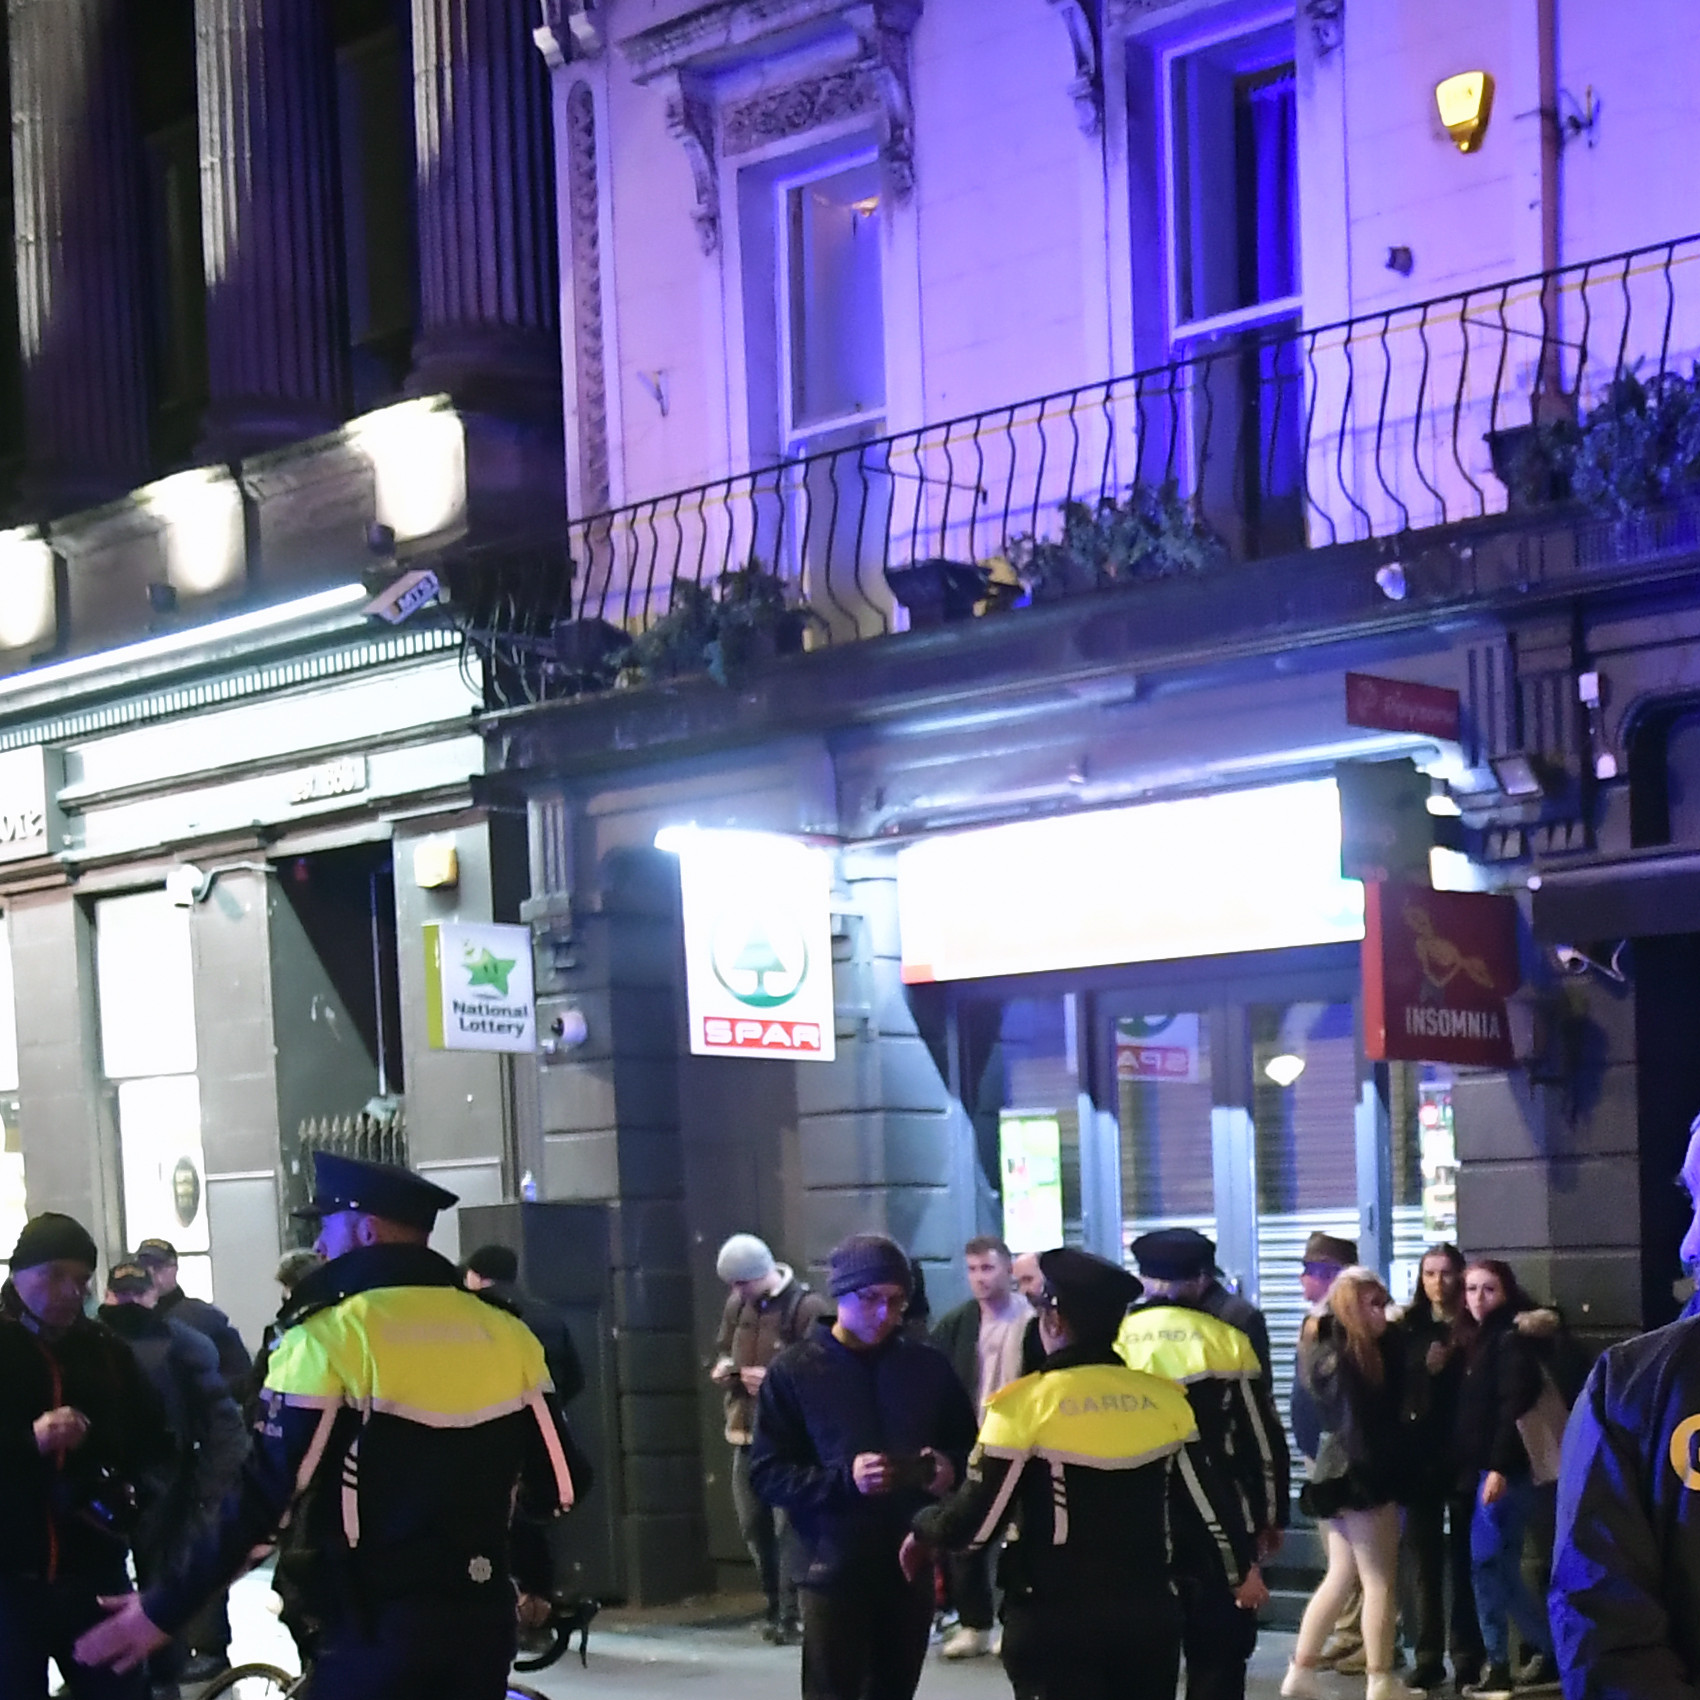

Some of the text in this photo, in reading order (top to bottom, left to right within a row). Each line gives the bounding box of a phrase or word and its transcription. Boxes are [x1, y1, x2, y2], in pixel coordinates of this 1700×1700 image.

[453, 998, 528, 1017] National
[459, 1016, 525, 1038] Lottery
[705, 1019, 820, 1049] SPAR
[1405, 1006, 1501, 1040] INSOMNIA
[1059, 1394, 1160, 1416] GARDA
